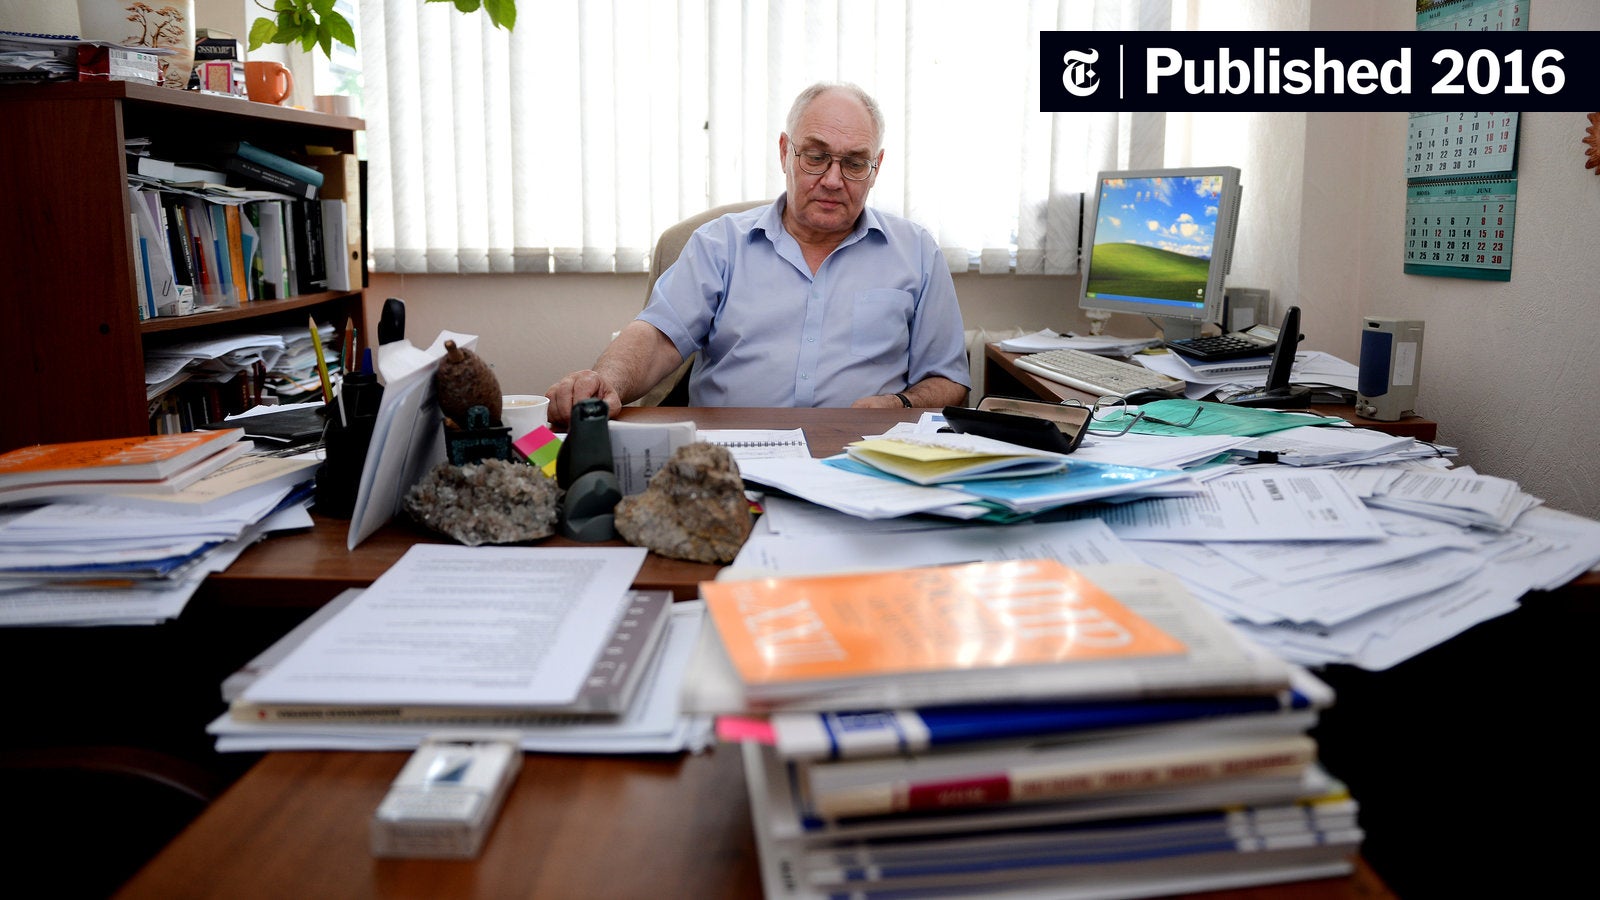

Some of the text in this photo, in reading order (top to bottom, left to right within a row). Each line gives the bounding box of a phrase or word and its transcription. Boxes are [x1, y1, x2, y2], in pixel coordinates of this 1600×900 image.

[1468, 18, 1473, 27] 2
[1483, 14, 1488, 22] 3
[1498, 9, 1503, 17] 4
[1514, 5, 1519, 13] 5
[1496, 23, 1503, 31] 11
[1512, 18, 1520, 27] 12
[198, 45, 235, 57] Larousse
[1418, 130, 1422, 138] 6
[1472, 123, 1479, 131] 10
[1488, 120, 1494, 129] 11
[1502, 118, 1510, 127] 12
[1428, 140, 1435, 148] 14
[1470, 135, 1478, 143] 17
[1486, 133, 1494, 141] 18
[1501, 131, 1509, 140] 19
[1415, 153, 1421, 161] 20
[1427, 152, 1434, 160] 21
[1454, 149, 1462, 157] 23
[1469, 148, 1477, 156] 24
[1485, 146, 1493, 154] 25
[1498, 144, 1507, 153] 26
[1453, 161, 1460, 169] 30
[1468, 160, 1476, 168] 31
[1424, 217, 1427, 225] 4
[1437, 217, 1440, 225] 5
[1451, 217, 1455, 225] 6
[1466, 217, 1470, 225] 7
[1481, 217, 1485, 225] 8
[1497, 217, 1502, 225] 9
[1435, 229, 1441, 237] 12
[1479, 230, 1486, 238] 15
[1495, 230, 1504, 238] 16
[1447, 241, 1455, 249] 20
[1478, 242, 1485, 250] 22
[1493, 243, 1503, 251] 23
[1447, 253, 1454, 261] 27
[1461, 254, 1469, 262] 28
[1477, 255, 1484, 263] 29
